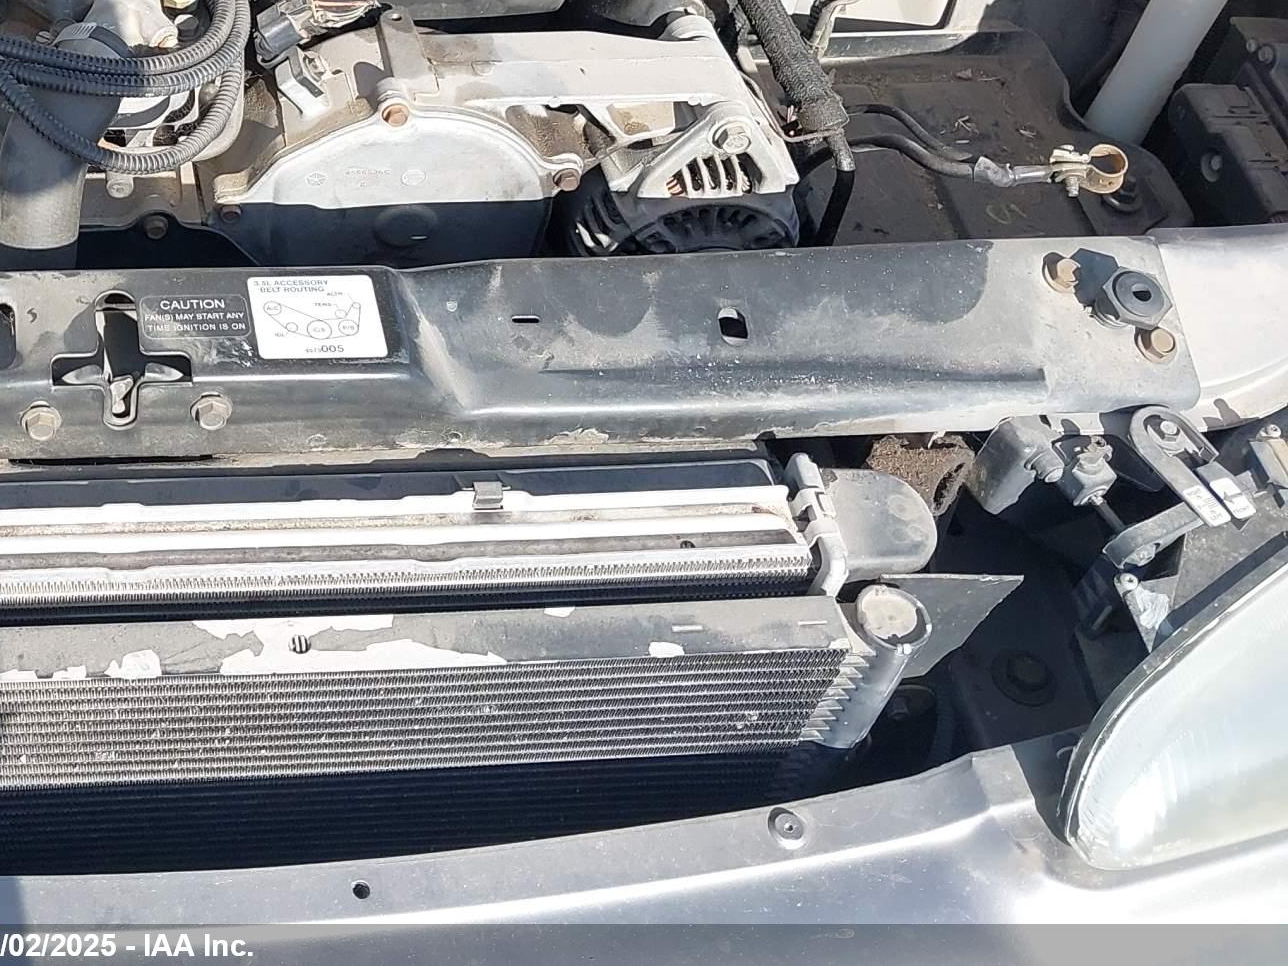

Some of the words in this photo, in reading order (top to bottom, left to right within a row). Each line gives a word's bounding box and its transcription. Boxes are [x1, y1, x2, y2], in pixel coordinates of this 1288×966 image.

[160, 299, 225, 310] CAUTION
[144, 313, 173, 322] FAN(S)
[175, 313, 194, 321] MAY
[196, 312, 224, 320] START
[226, 312, 244, 320] ANY
[147, 324, 171, 332] TIME
[173, 323, 216, 331] IGNITION
[219, 323, 229, 331] IS
[231, 322, 246, 330] ON
